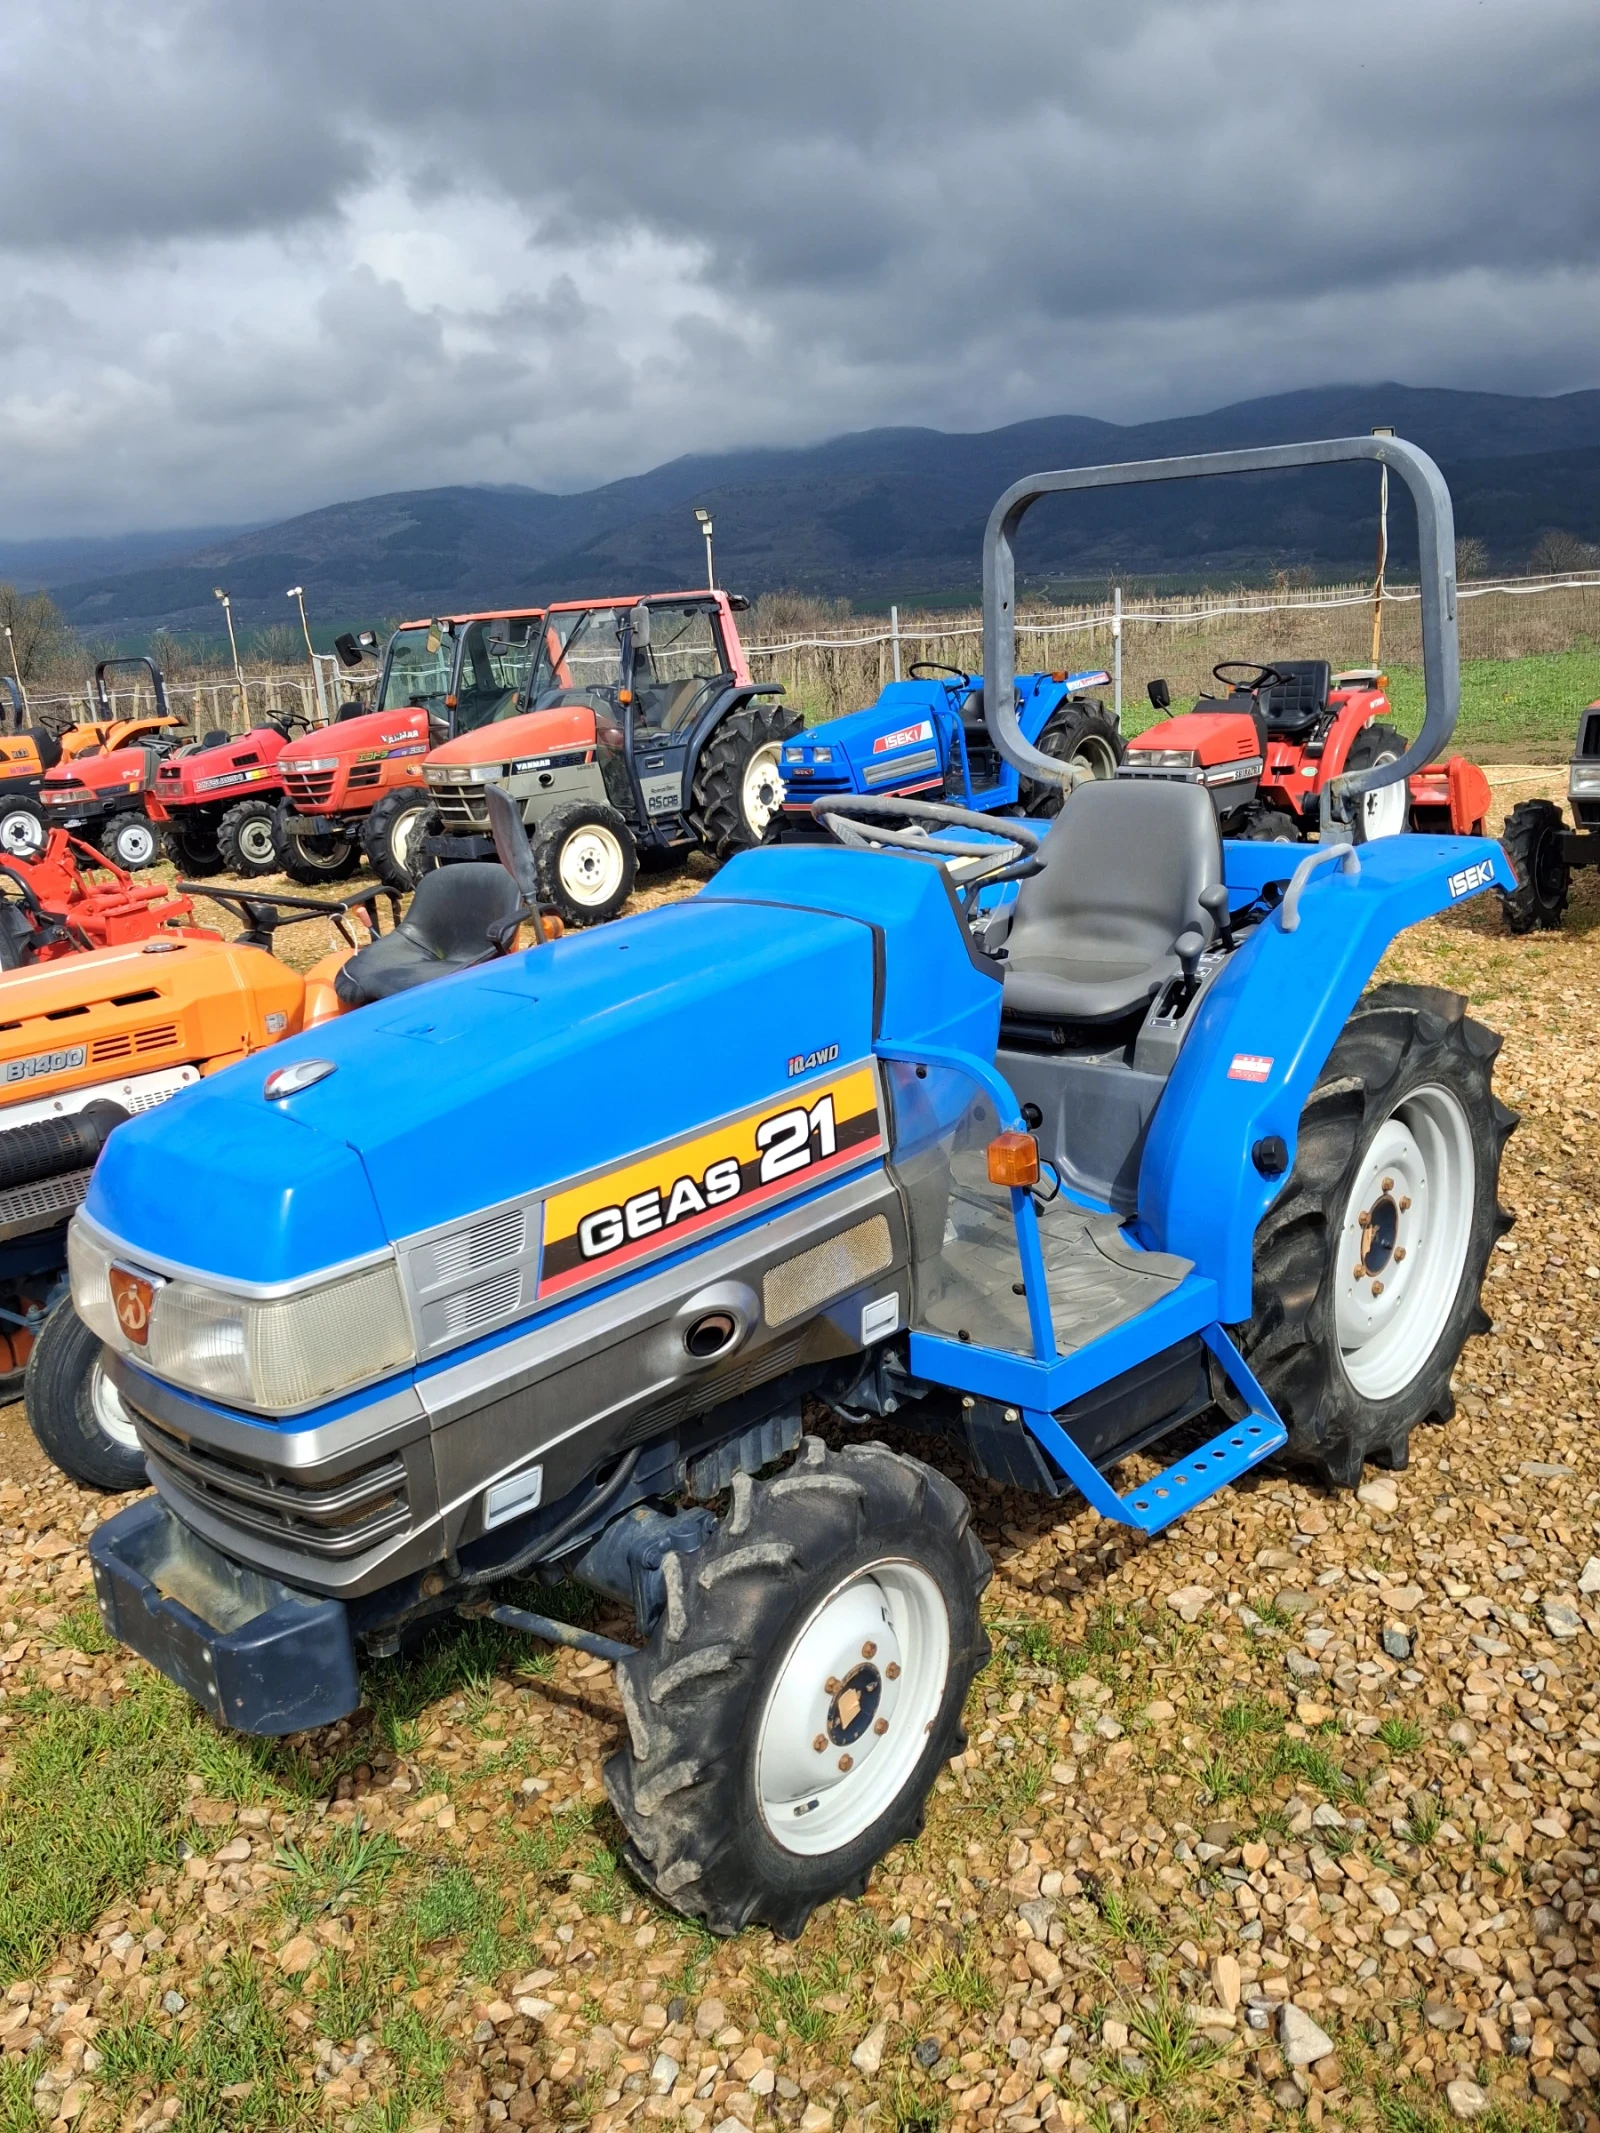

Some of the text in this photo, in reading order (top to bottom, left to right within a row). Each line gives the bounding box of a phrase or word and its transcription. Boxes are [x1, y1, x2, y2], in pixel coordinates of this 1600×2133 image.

[884, 729, 919, 749] ISEKI
[515, 758, 551, 771] YANMAR
[1447, 858, 1495, 899] ISEKI
[7, 1048, 84, 1082] B1400
[578, 1092, 838, 1260] GEAS 21
